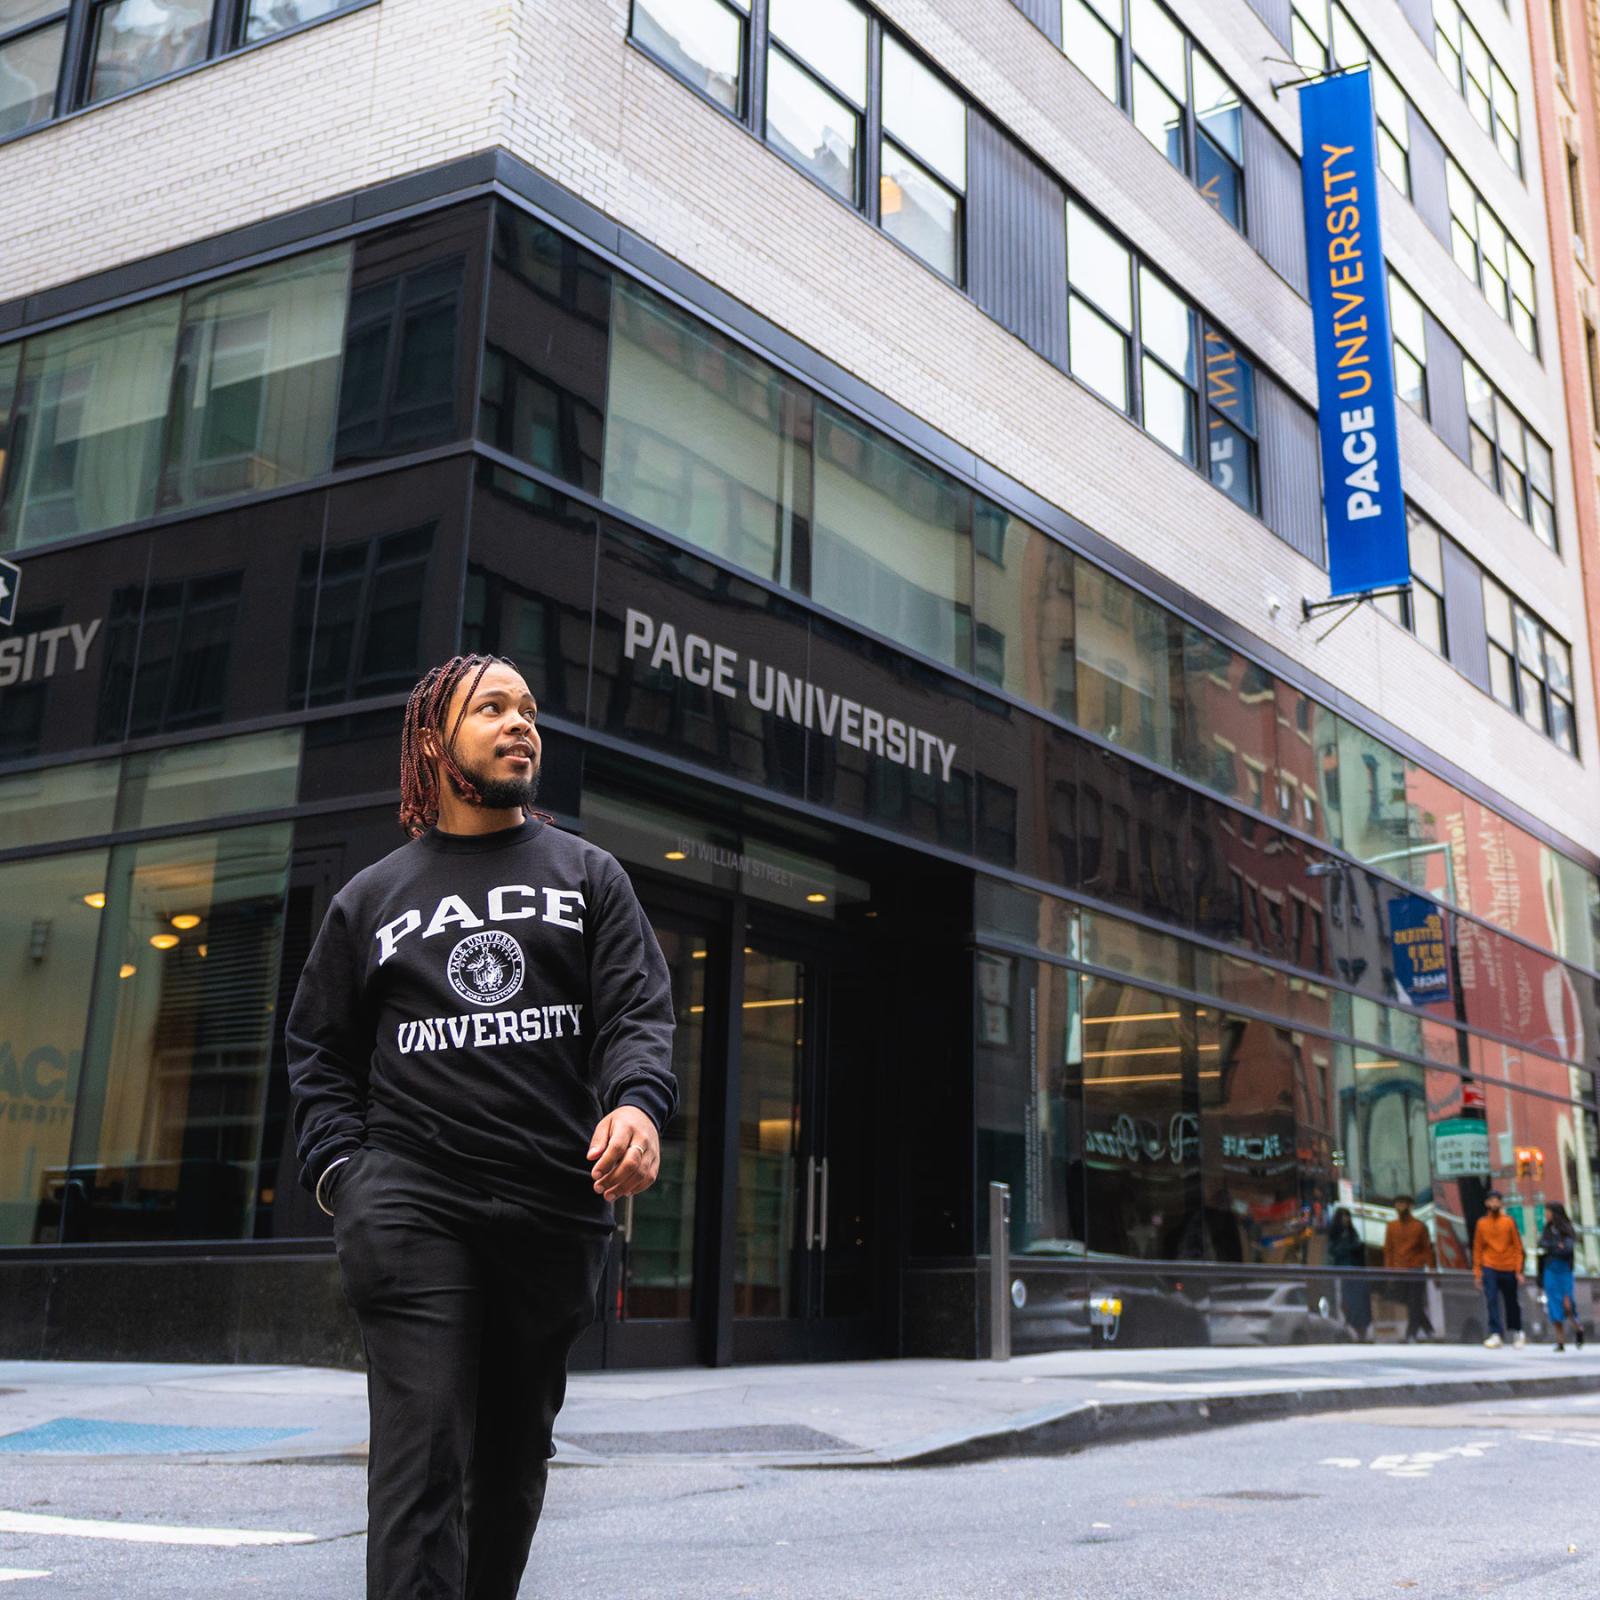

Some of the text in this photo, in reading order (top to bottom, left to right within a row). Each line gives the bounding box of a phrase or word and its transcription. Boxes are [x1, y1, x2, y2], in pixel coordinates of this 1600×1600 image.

[1321, 142, 1382, 521] PACE UNIVERSITY
[624, 607, 957, 783] PACE UNIVERSITY
[699, 842, 749, 873] WILLIAM
[751, 861, 794, 888] STREET
[375, 884, 587, 966] PACE
[450, 932, 522, 974] PACE UNIVERSITY
[397, 1003, 584, 1055] UNIVERSITY
